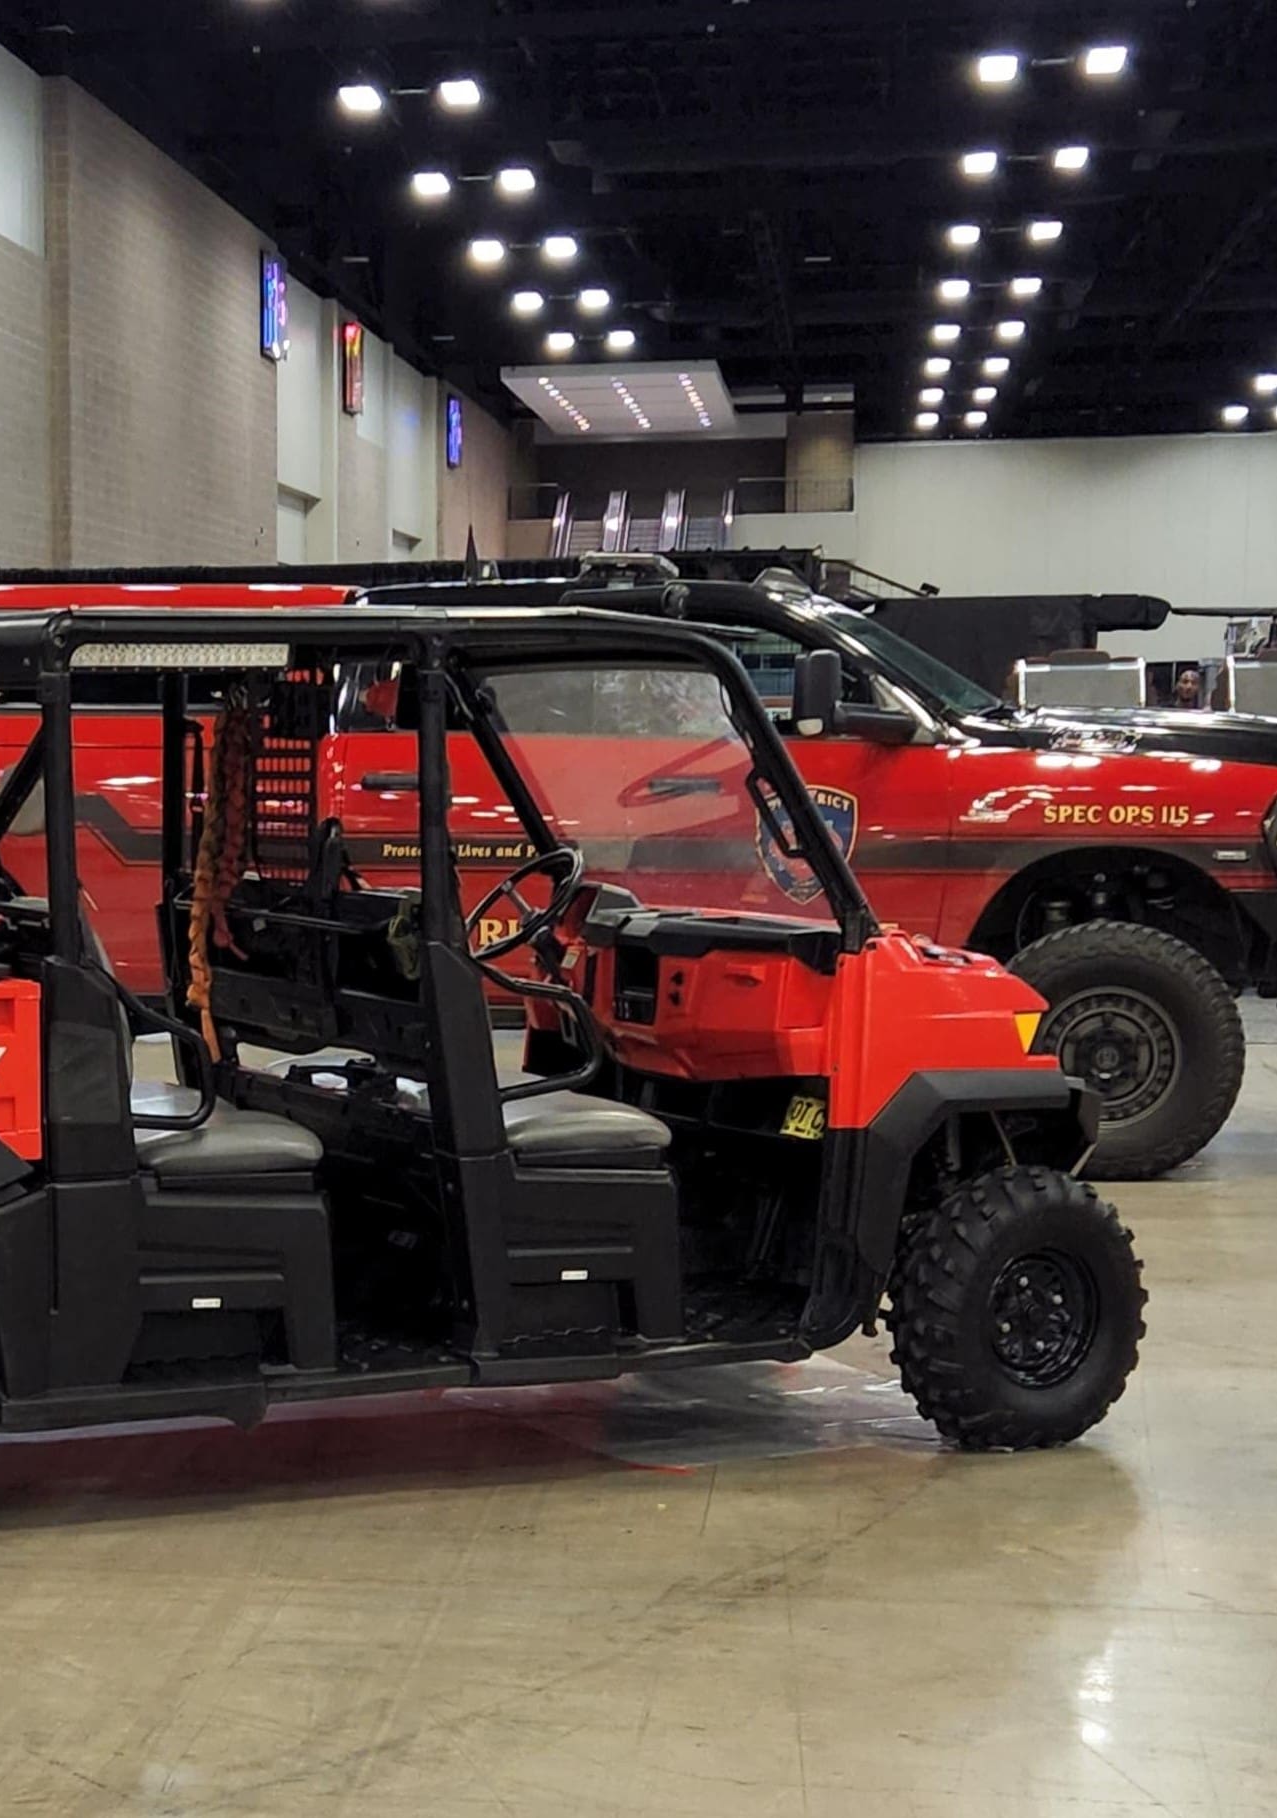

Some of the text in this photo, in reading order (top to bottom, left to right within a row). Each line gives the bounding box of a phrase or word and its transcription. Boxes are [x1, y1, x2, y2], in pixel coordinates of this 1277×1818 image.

[1043, 805, 1103, 823] SPEC
[1108, 805, 1154, 824] OPS
[383, 844, 421, 857] Prote
[458, 844, 491, 858] Lives
[496, 842, 523, 857] and
